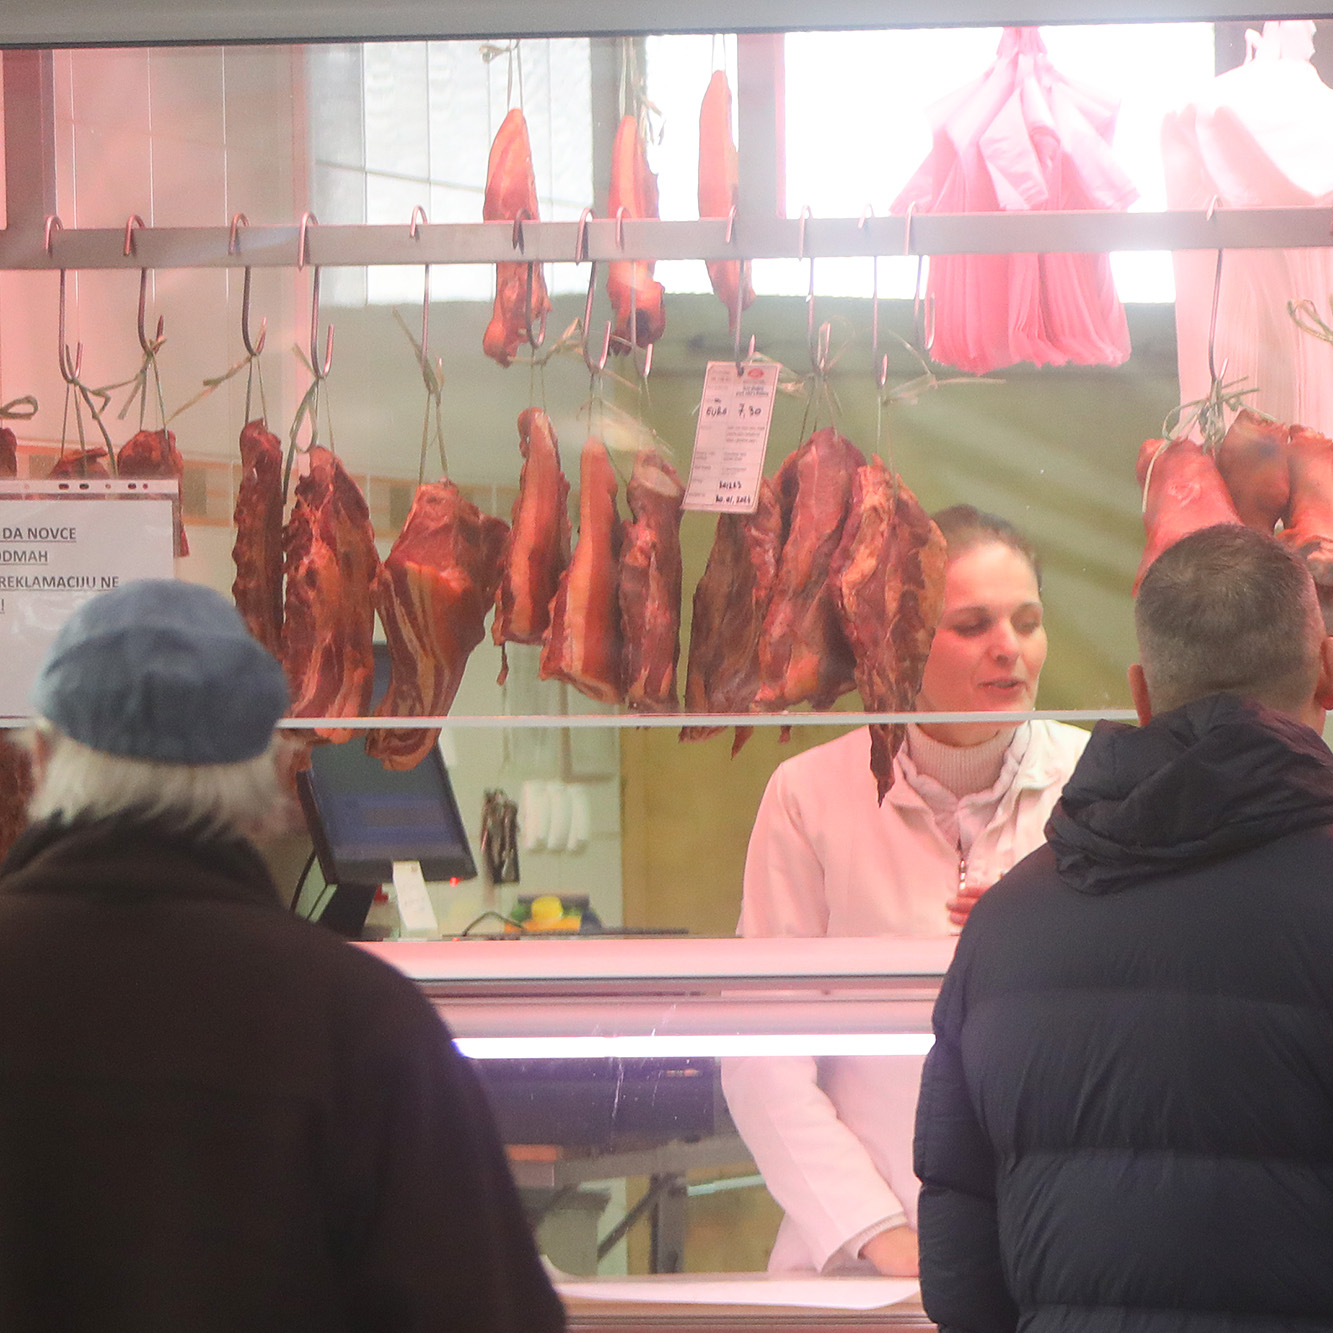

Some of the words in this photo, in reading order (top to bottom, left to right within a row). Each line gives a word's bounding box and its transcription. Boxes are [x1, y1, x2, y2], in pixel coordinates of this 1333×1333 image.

[3, 528, 23, 540] DA
[28, 527, 76, 540] NOVCE
[101, 576, 119, 589] NE
